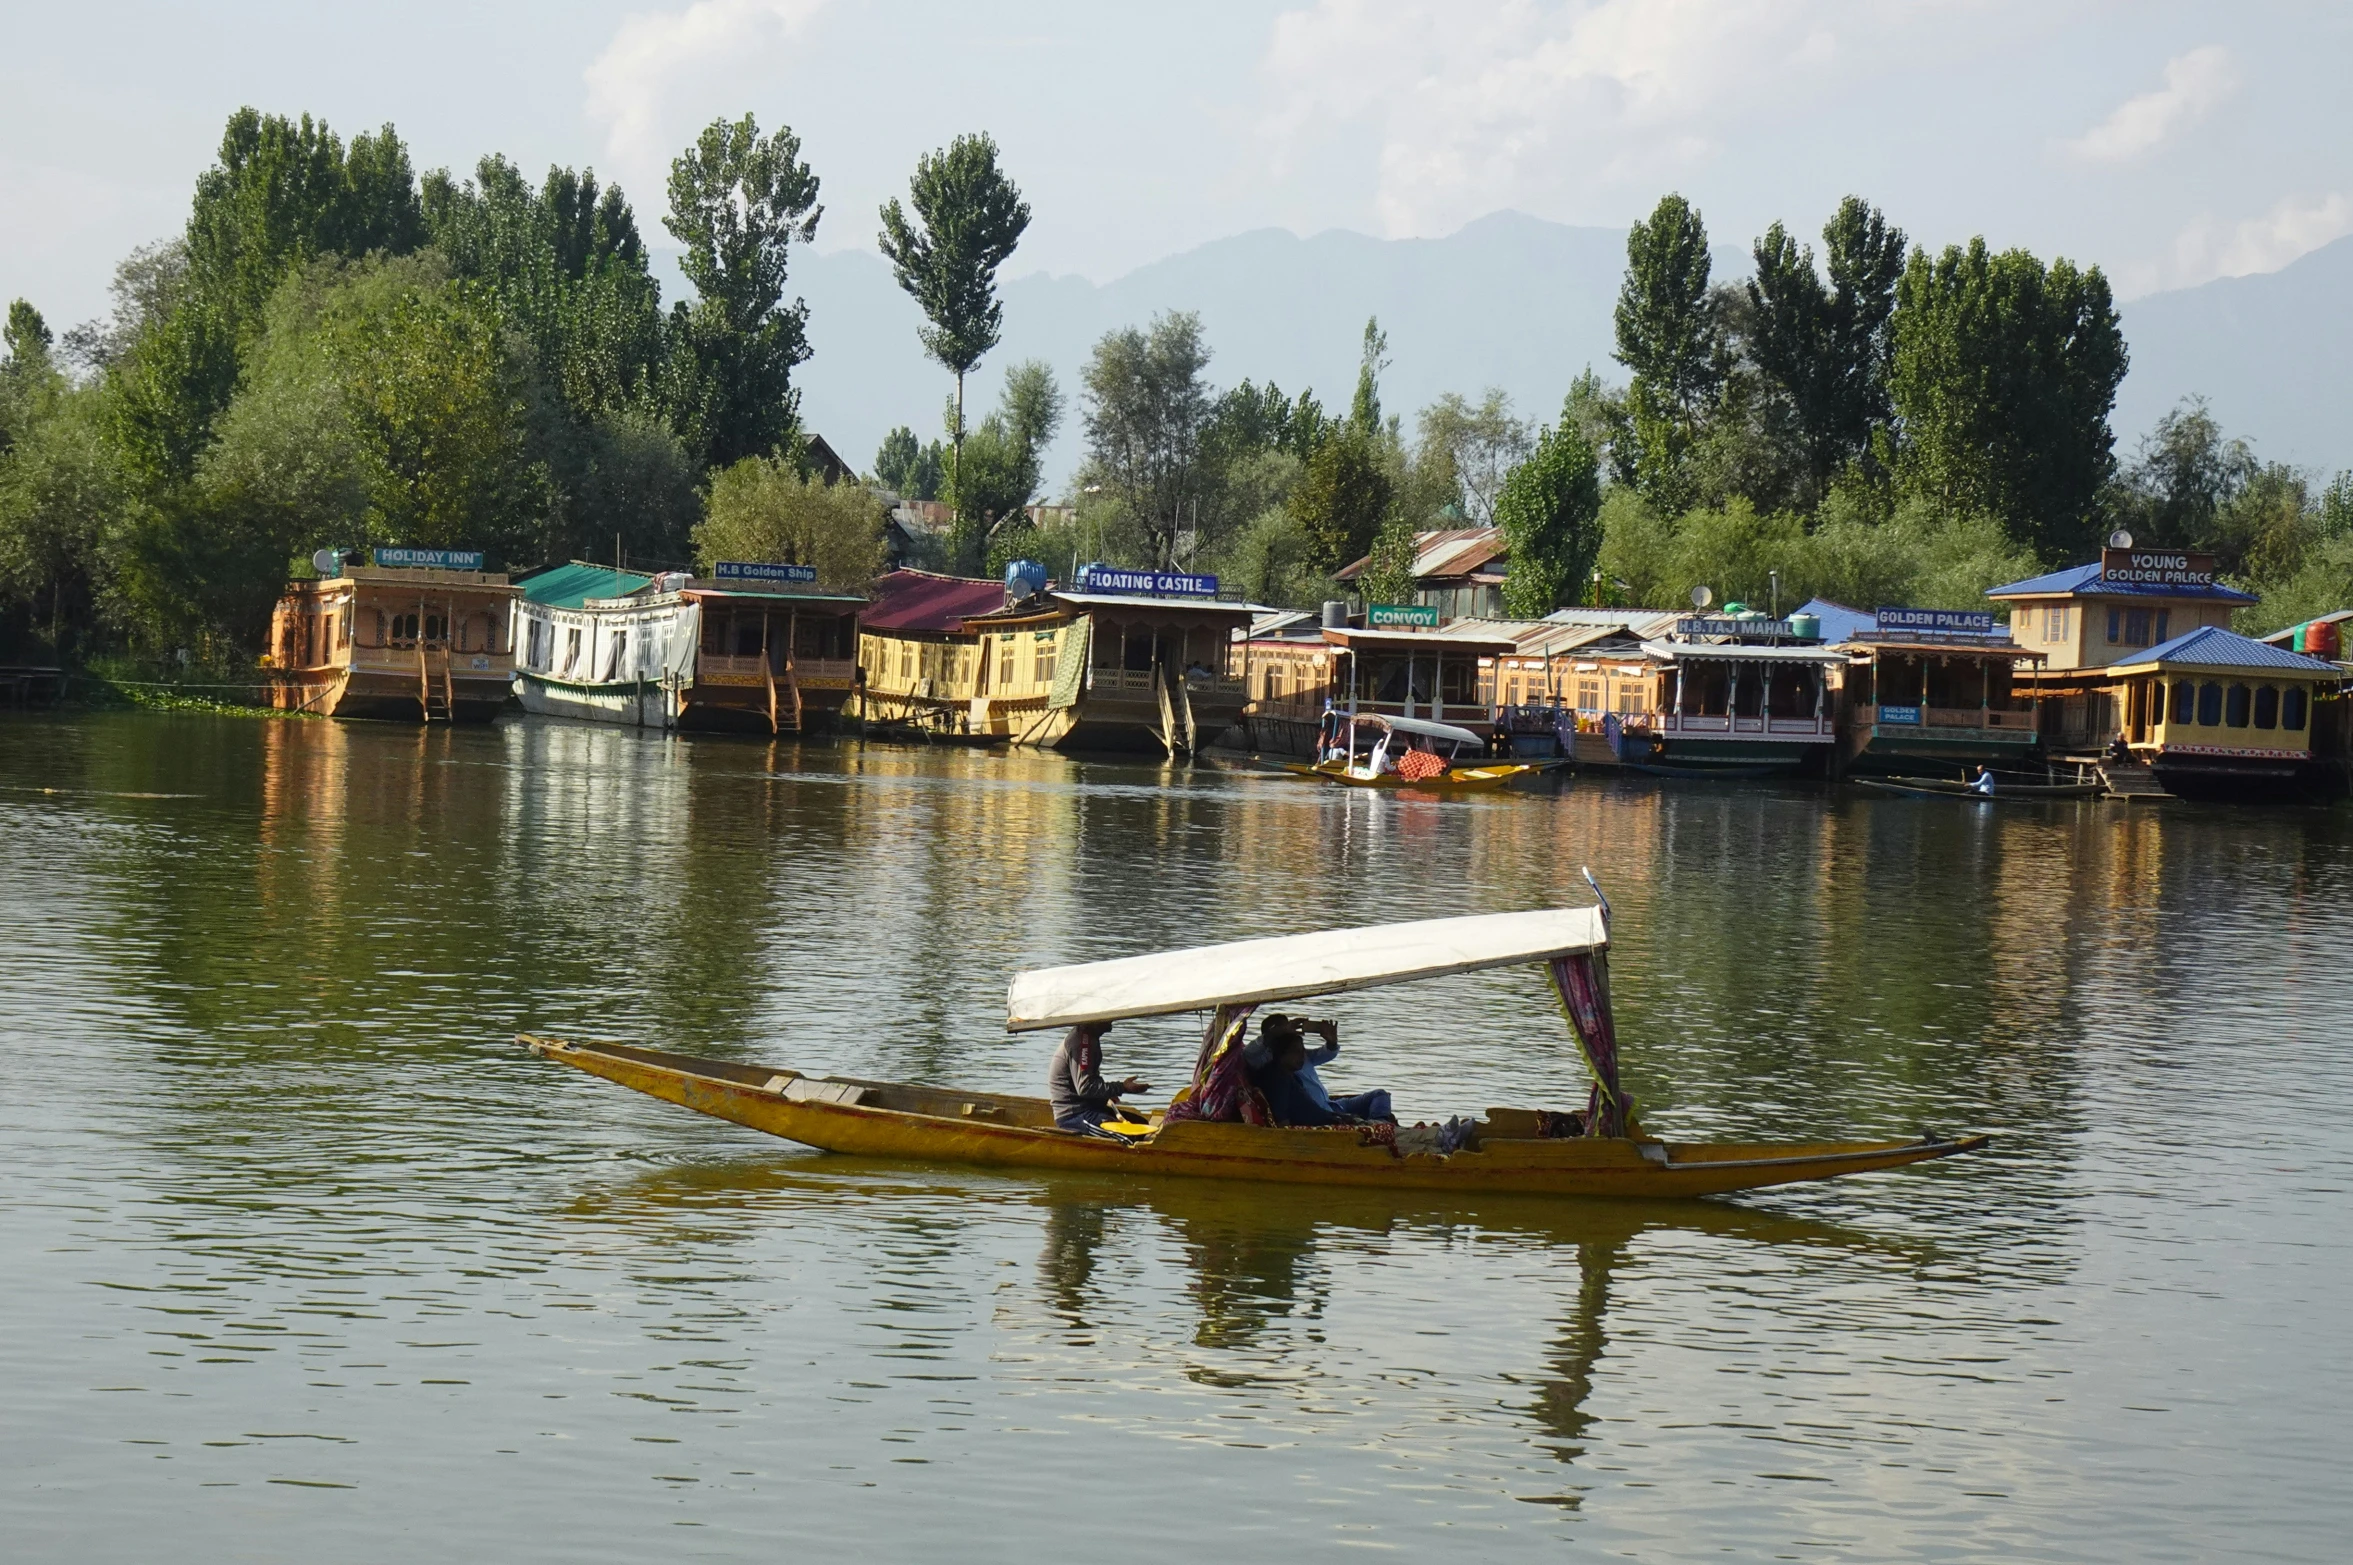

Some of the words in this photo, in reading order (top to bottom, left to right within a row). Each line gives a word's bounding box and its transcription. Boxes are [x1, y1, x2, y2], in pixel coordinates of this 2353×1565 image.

[382, 548, 445, 563] HOLIDAY
[449, 551, 474, 564] INN
[2131, 554, 2188, 569] YOUNG
[718, 565, 739, 574] H.B
[743, 565, 784, 576] Golden
[788, 568, 814, 580] Ship
[2106, 569, 2160, 582] GOLDEN
[2165, 571, 2212, 583] PALACE
[1089, 573, 1153, 589] FLOATING
[1157, 576, 1202, 591] CASTLE
[1373, 611, 1433, 625] CONVOY
[1879, 611, 1933, 625] GOLDEN
[1937, 614, 1990, 627] PALACE
[1741, 622, 1793, 635] MAHAL
